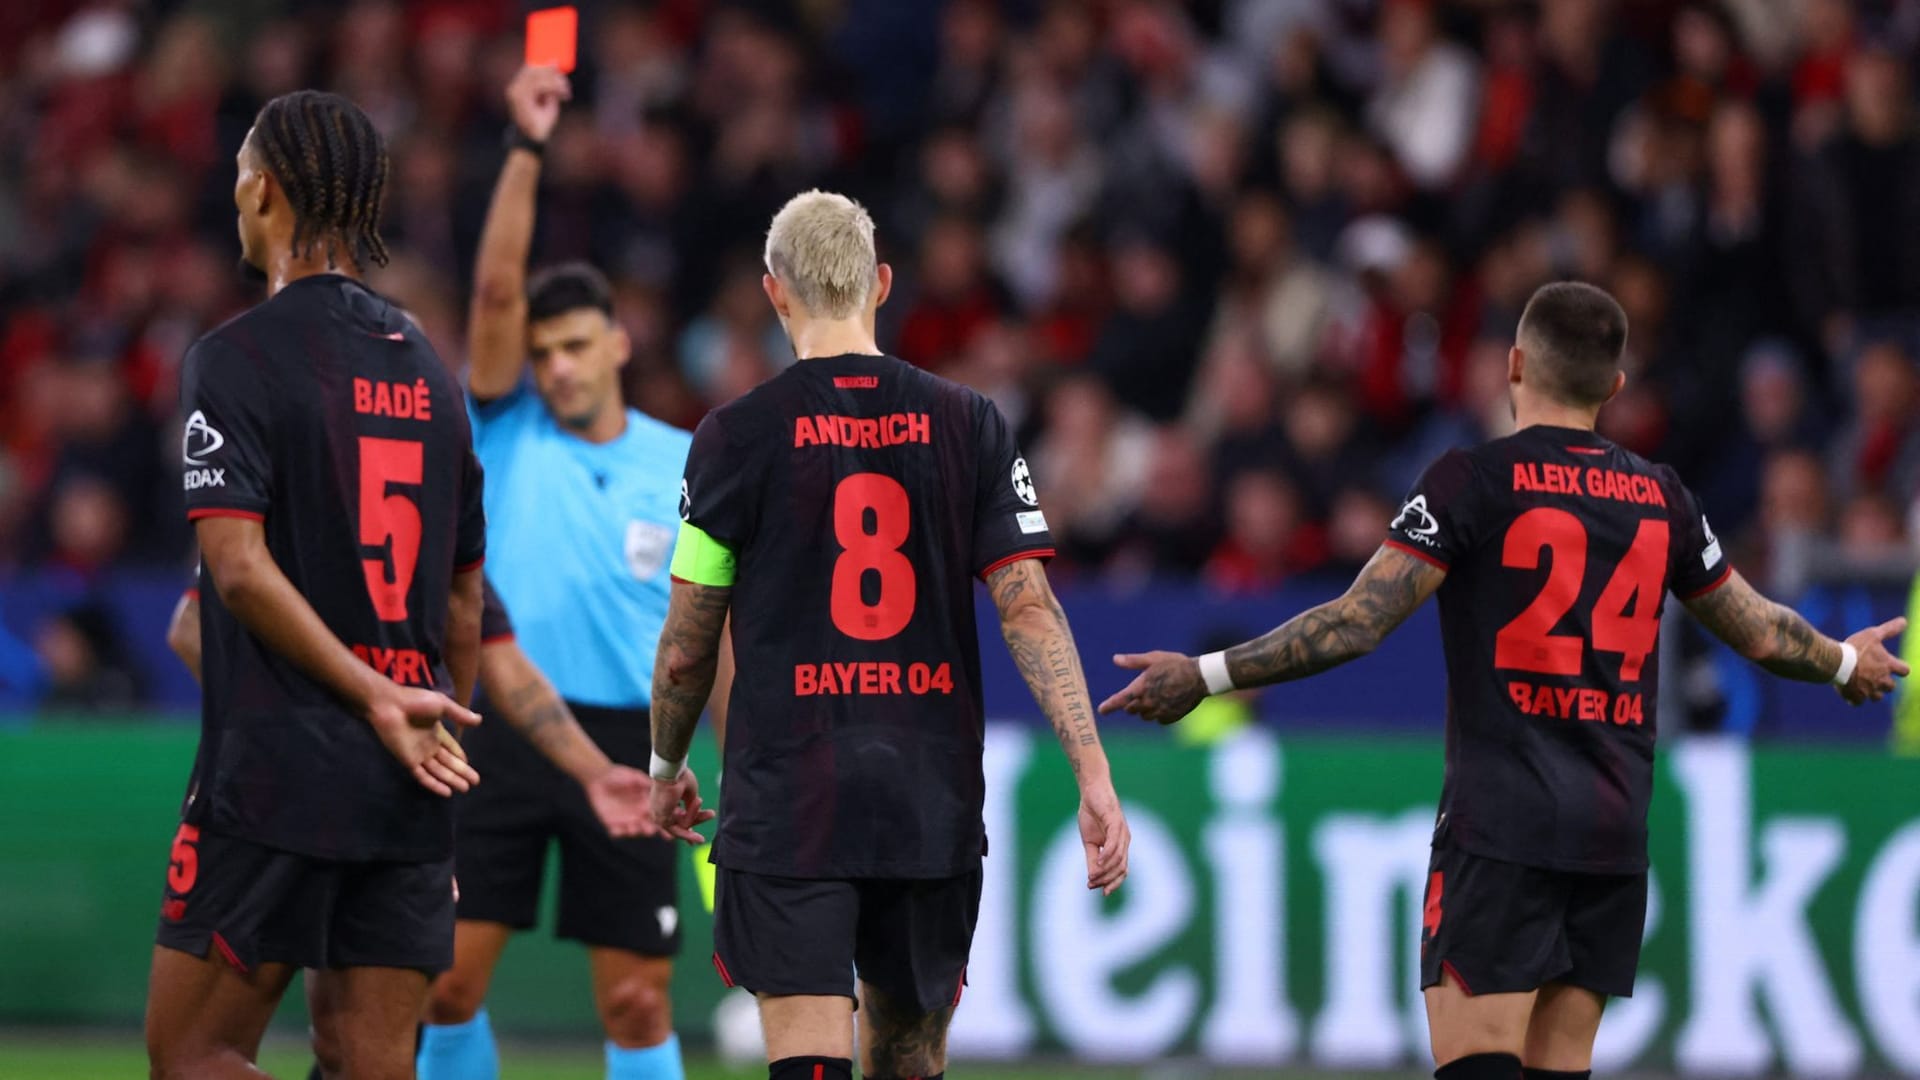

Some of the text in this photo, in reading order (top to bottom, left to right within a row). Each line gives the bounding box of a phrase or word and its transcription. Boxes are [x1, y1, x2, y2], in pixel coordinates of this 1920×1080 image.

[353, 377, 432, 421] BADÉ
[793, 412, 930, 449] ANDRICH
[1513, 463, 1667, 509] ALEIX GARCIA
[358, 436, 424, 622] 5
[830, 472, 917, 641] 8
[1494, 506, 1670, 681] 24
[795, 661, 954, 697] BAYER 04
[1507, 681, 1644, 726] BAYER 04
[167, 823, 200, 895] 5
